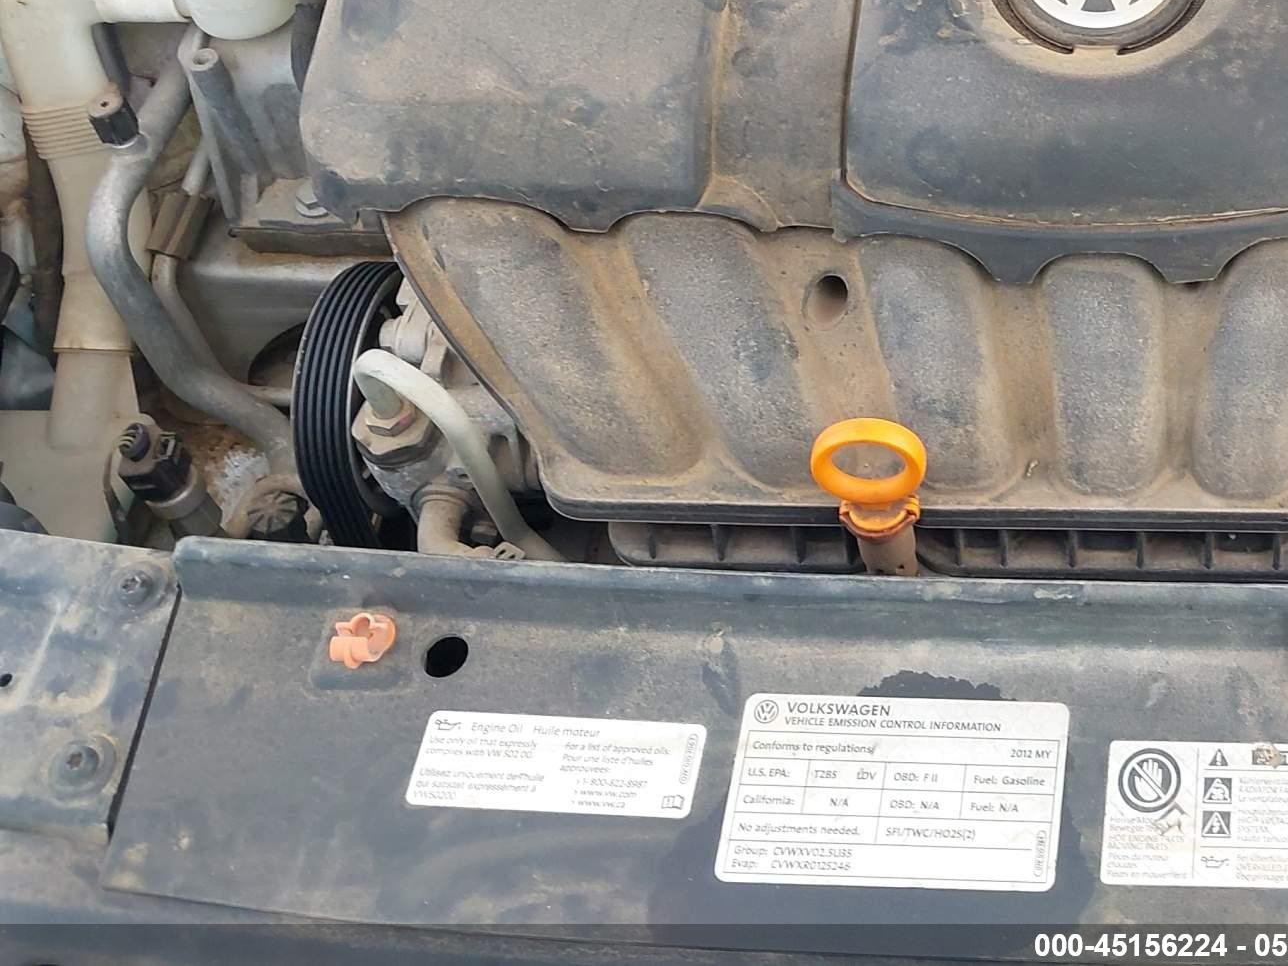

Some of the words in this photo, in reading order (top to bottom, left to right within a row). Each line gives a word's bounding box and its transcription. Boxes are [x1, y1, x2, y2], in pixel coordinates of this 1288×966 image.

[787, 702, 891, 716] VOLKSWAGEN
[471, 722, 506, 734] Engine
[508, 722, 523, 733] Oil
[785, 716, 825, 726] VEHICLE
[828, 718, 877, 728] EMISSION
[880, 719, 926, 729] CONTROL
[930, 721, 1001, 732] INFORMATION
[533, 724, 561, 736] Huile
[752, 740, 800, 751] Conforms
[803, 742, 813, 751] to
[1010, 749, 1033, 758] 2012
[1035, 750, 1052, 759] MY
[748, 768, 767, 777] U.S.
[769, 768, 790, 777] EPA:
[973, 775, 998, 784] Fuel:
[1002, 776, 1046, 786] Gasoline
[743, 795, 795, 805] California:
[829, 797, 849, 807] N/A
[920, 800, 940, 810] N/A
[999, 804, 1019, 813] N/A
[738, 822, 752, 832] No
[754, 823, 818, 835] adjustments
